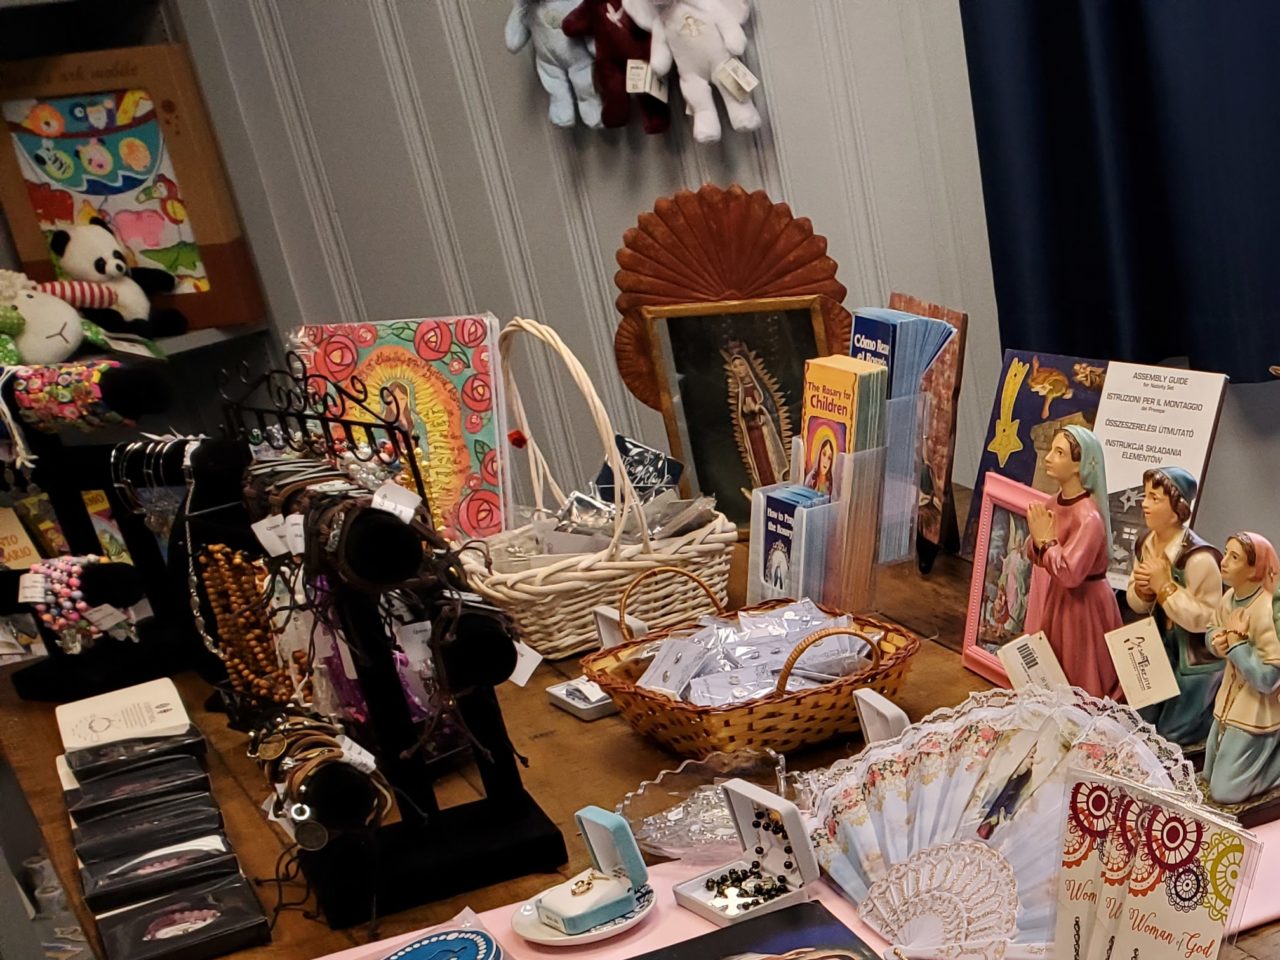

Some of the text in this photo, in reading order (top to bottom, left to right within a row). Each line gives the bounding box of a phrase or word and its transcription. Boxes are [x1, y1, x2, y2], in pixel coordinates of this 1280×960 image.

[854, 334, 876, 351] Cómo
[1133, 372, 1189, 386] ASSEMBLY GUIDE
[808, 382, 852, 400] The Rosary for
[810, 394, 848, 416] Children
[1107, 392, 1203, 411] ISTRUZIONI PER IL MONTAGGIO
[1105, 439, 1182, 456] INSTRUKCJA SKŁADANIA
[1122, 451, 1163, 464] ELEMENTÓW
[768, 521, 776, 532] the
[1129, 907, 1175, 945] Woman
[1182, 931, 1215, 959] God
